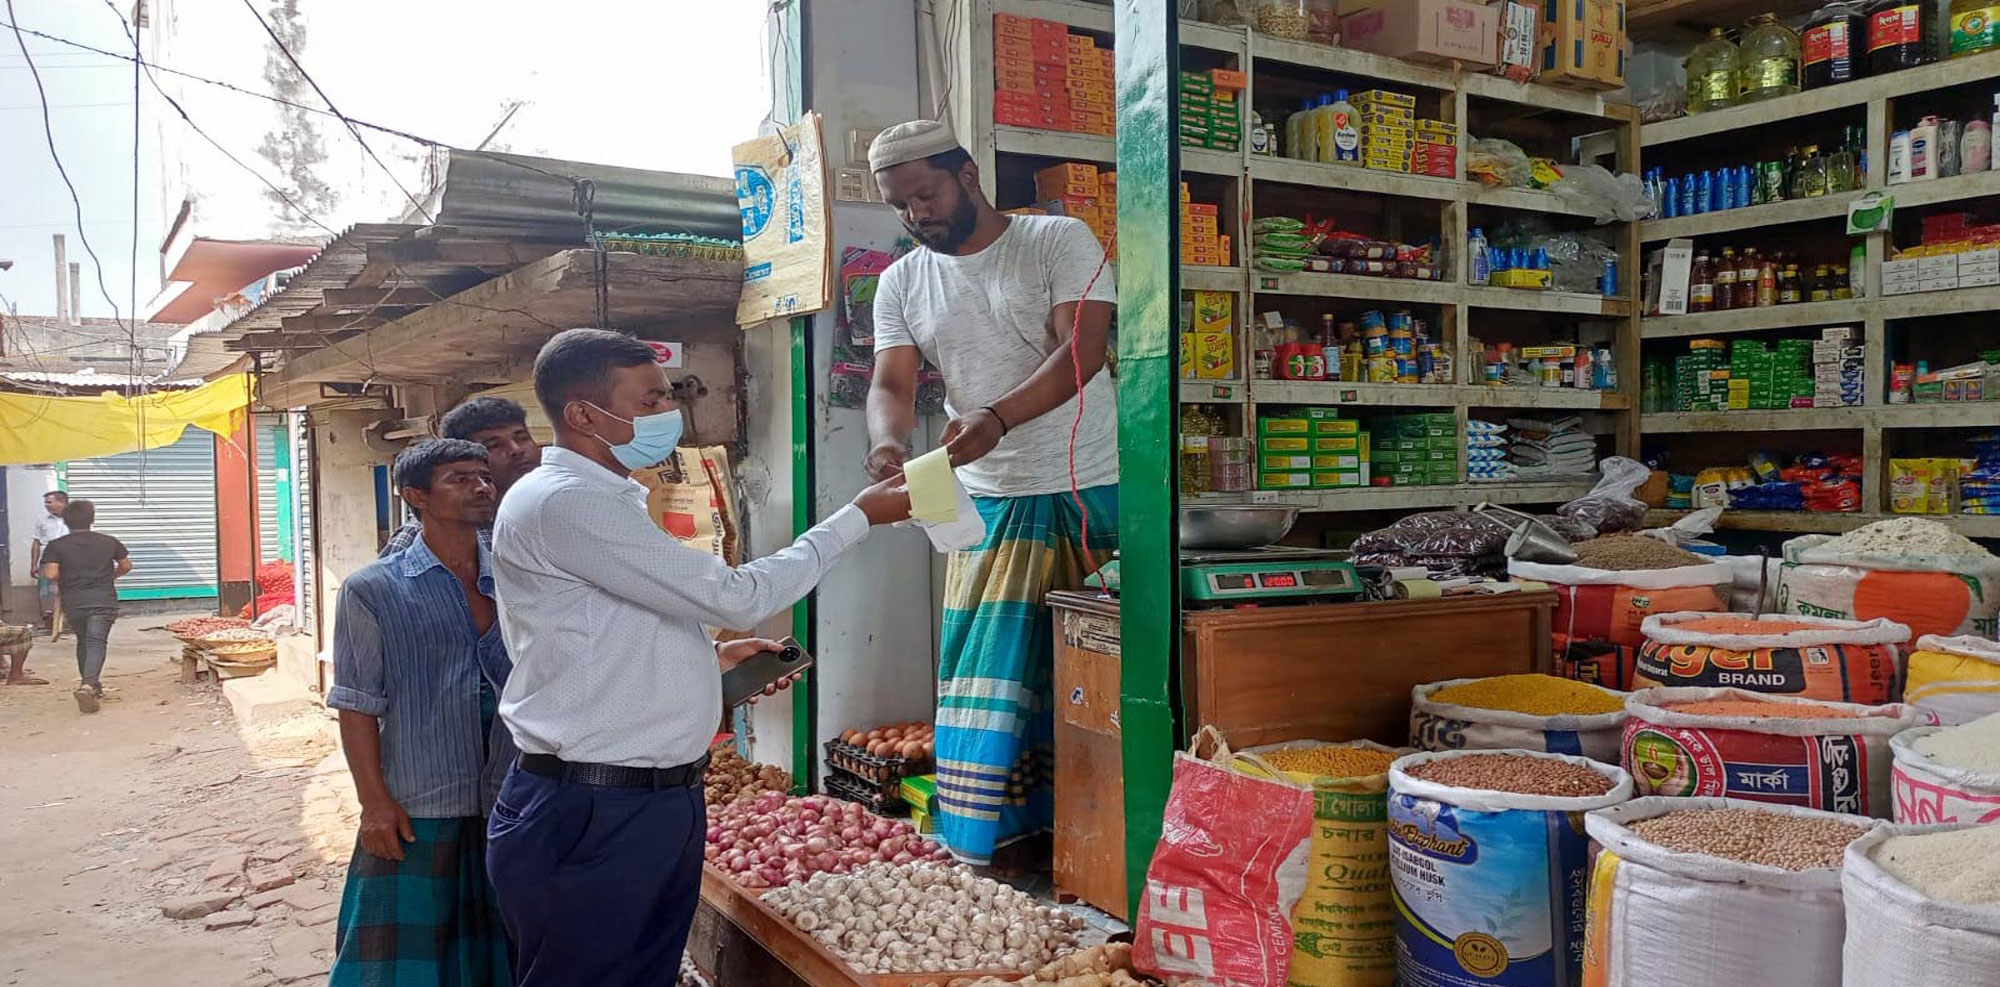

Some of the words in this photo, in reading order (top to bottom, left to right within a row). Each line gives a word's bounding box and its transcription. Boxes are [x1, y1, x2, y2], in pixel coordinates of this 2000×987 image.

[1718, 672, 1786, 686] BRAND
[1737, 768, 1790, 790] মার্কা
[1402, 823, 1470, 857] Elephant
[1402, 849, 1437, 873] ISABGOL
[1419, 868, 1446, 887] HUSK
